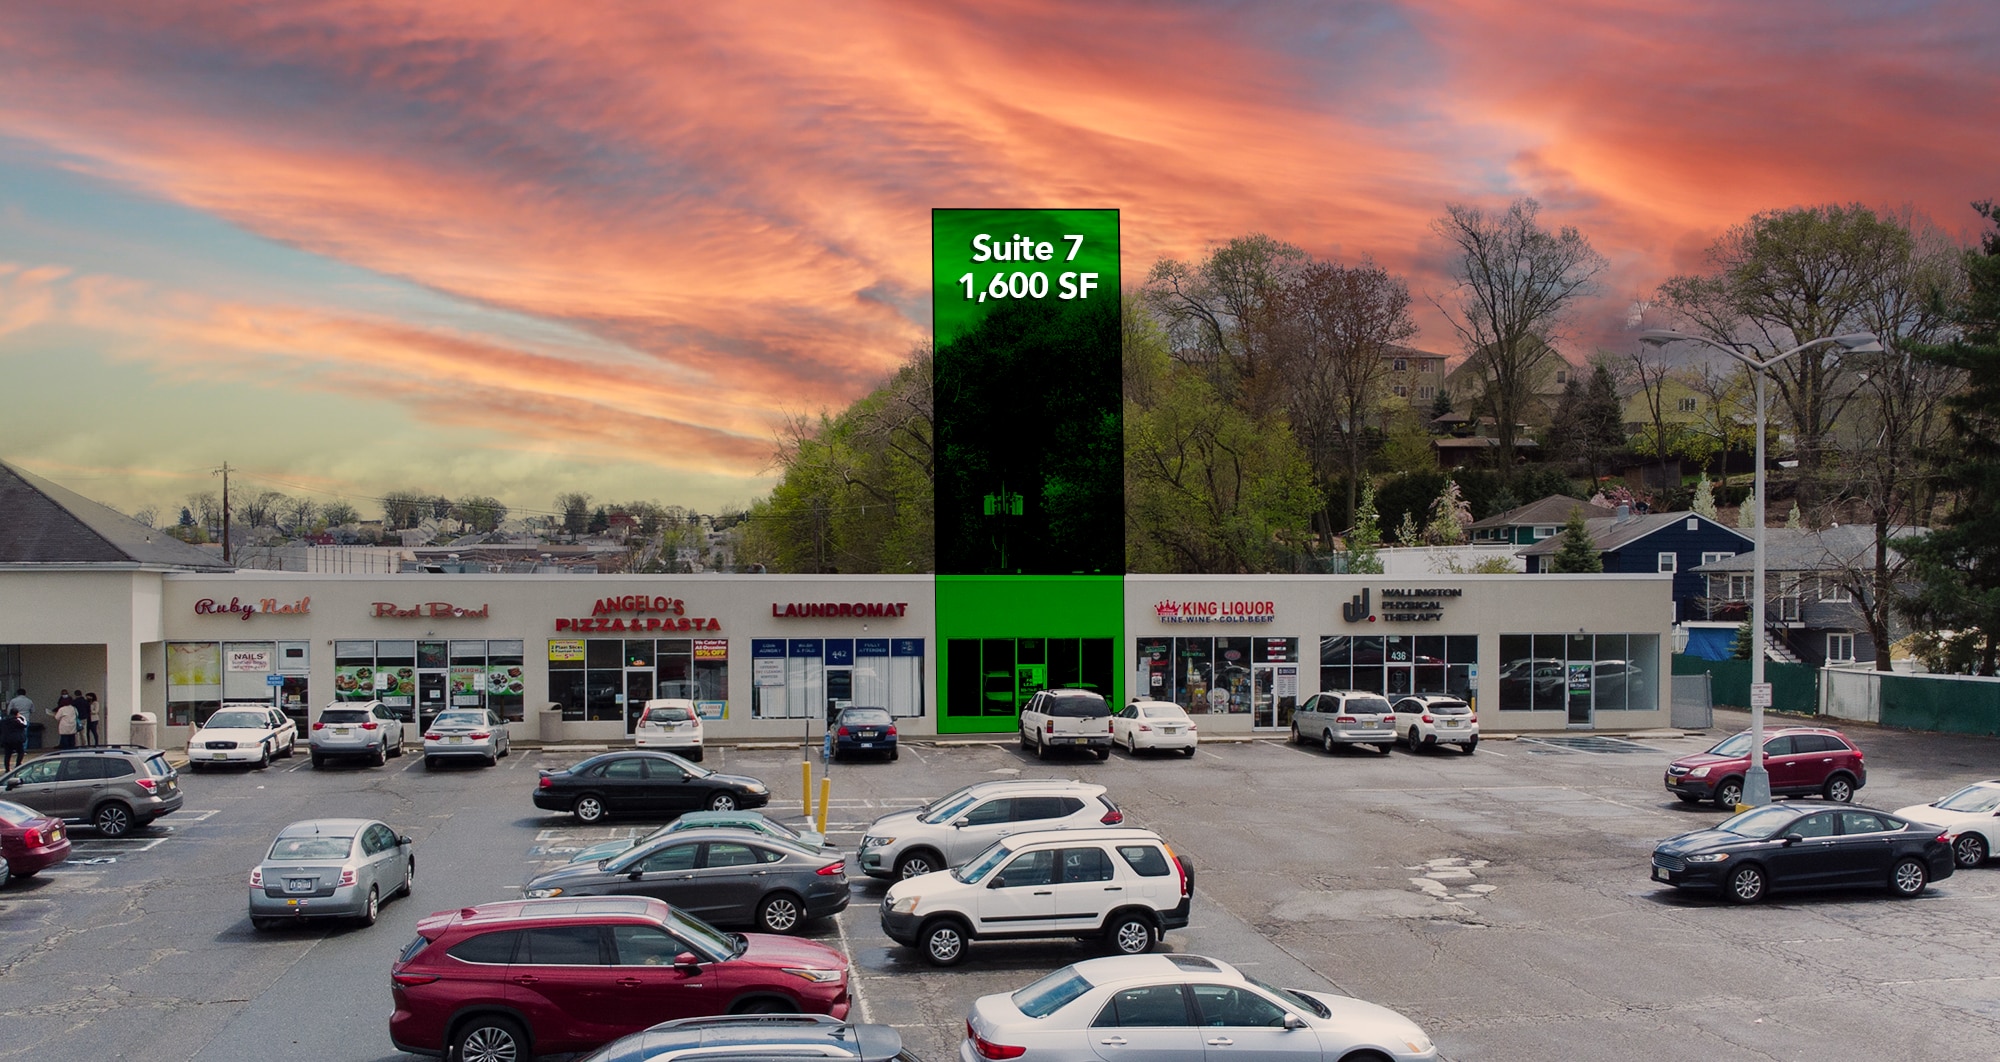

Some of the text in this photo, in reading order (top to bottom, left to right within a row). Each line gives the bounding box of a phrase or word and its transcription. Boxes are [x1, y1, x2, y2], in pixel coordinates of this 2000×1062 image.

[1381, 588, 1462, 597] WALLINGTON
[194, 596, 311, 621] Ruby Nail
[370, 602, 489, 618] Red Bowl
[591, 595, 685, 617] ANGELO'S
[772, 602, 908, 618] LAUNDROMAT
[1182, 601, 1274, 616] KING LIQUOR
[1381, 601, 1444, 610] PHYSICAL
[1161, 616, 1183, 624] FINE
[1186, 616, 1211, 624] WINE
[1219, 616, 1245, 624] COLD
[1382, 613, 1443, 622] THERAPY
[555, 618, 722, 633] PIZZA & PASTA
[1391, 651, 1407, 660] 436
